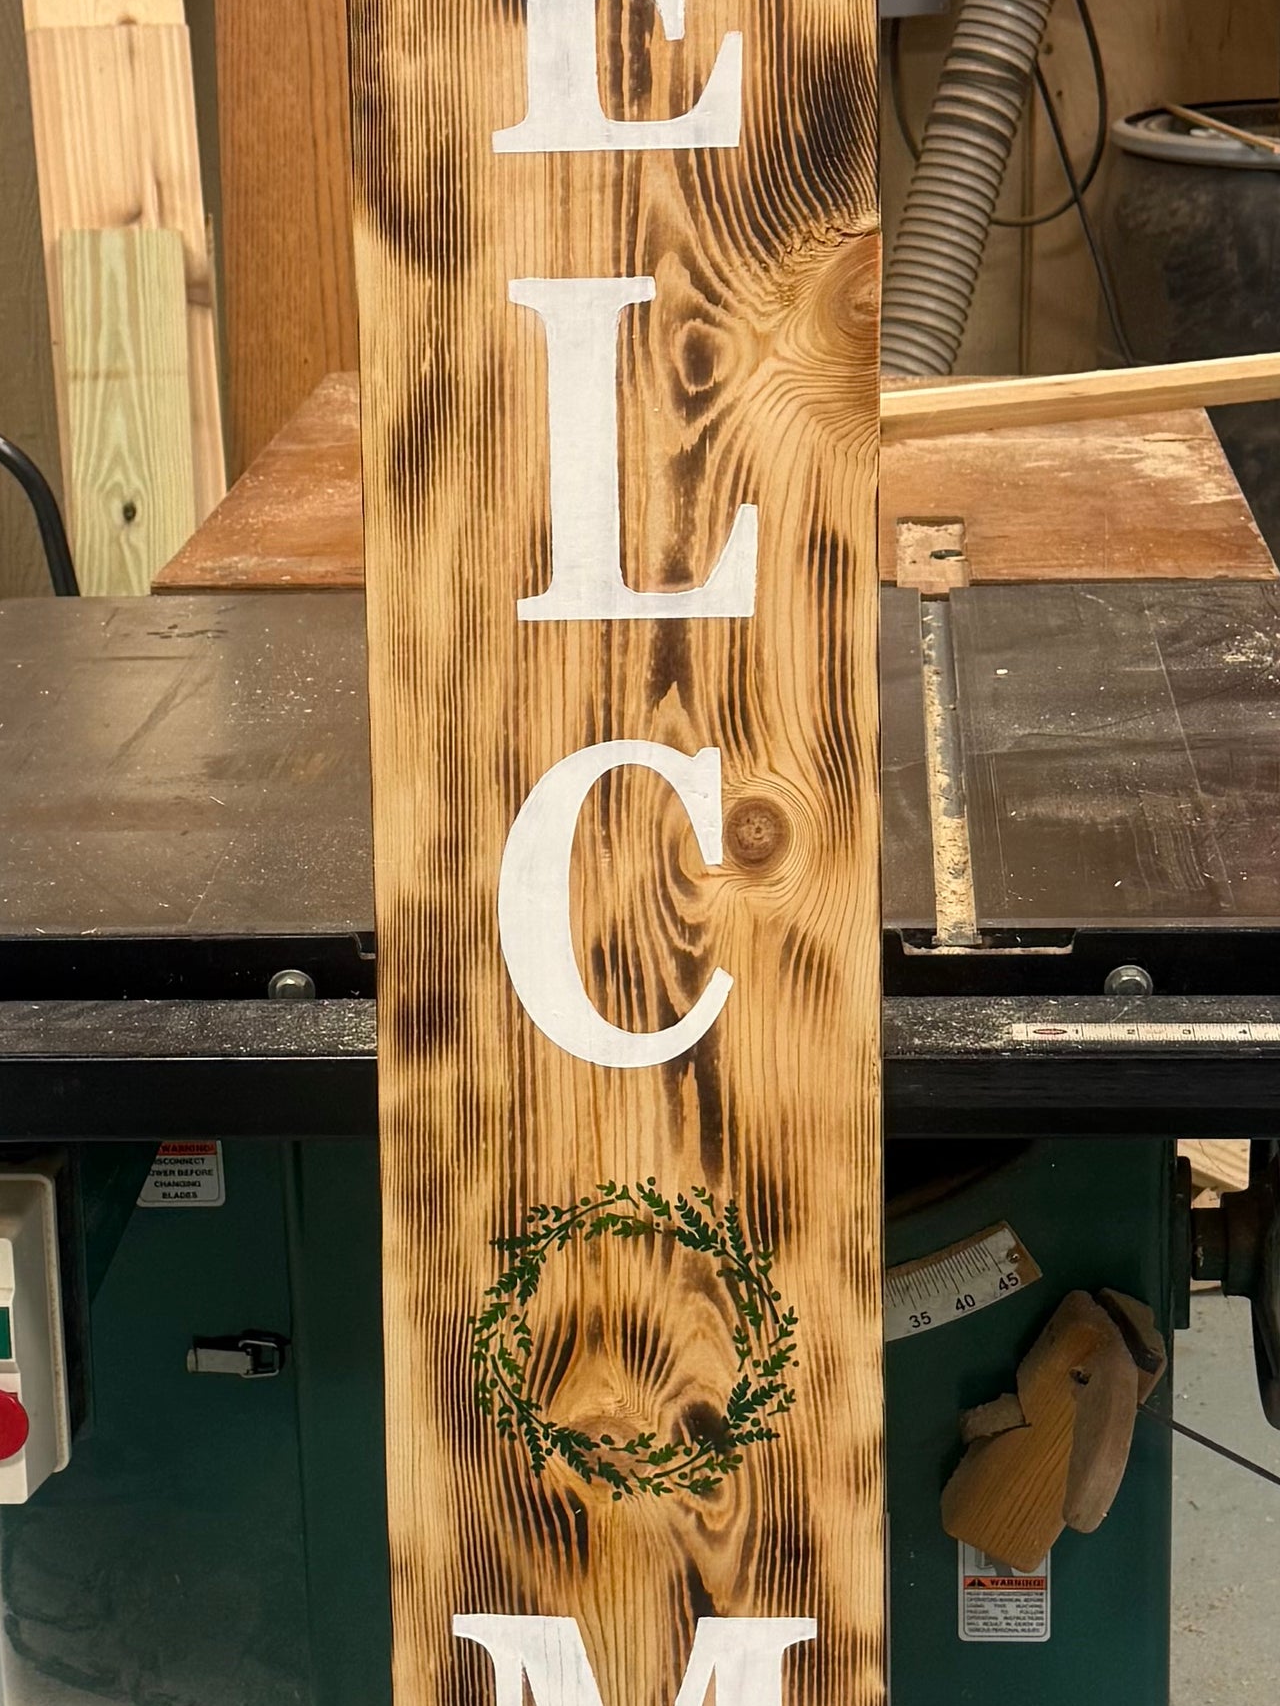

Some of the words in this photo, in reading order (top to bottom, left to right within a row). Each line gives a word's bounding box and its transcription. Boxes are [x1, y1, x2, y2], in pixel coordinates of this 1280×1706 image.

[177, 1168, 214, 1177] BEFORE
[154, 1180, 201, 1188] CHANGING
[161, 1191, 198, 1199] BLADES
[998, 1272, 1019, 1292] 45
[955, 1294, 976, 1312] 40
[909, 1311, 932, 1329] 35
